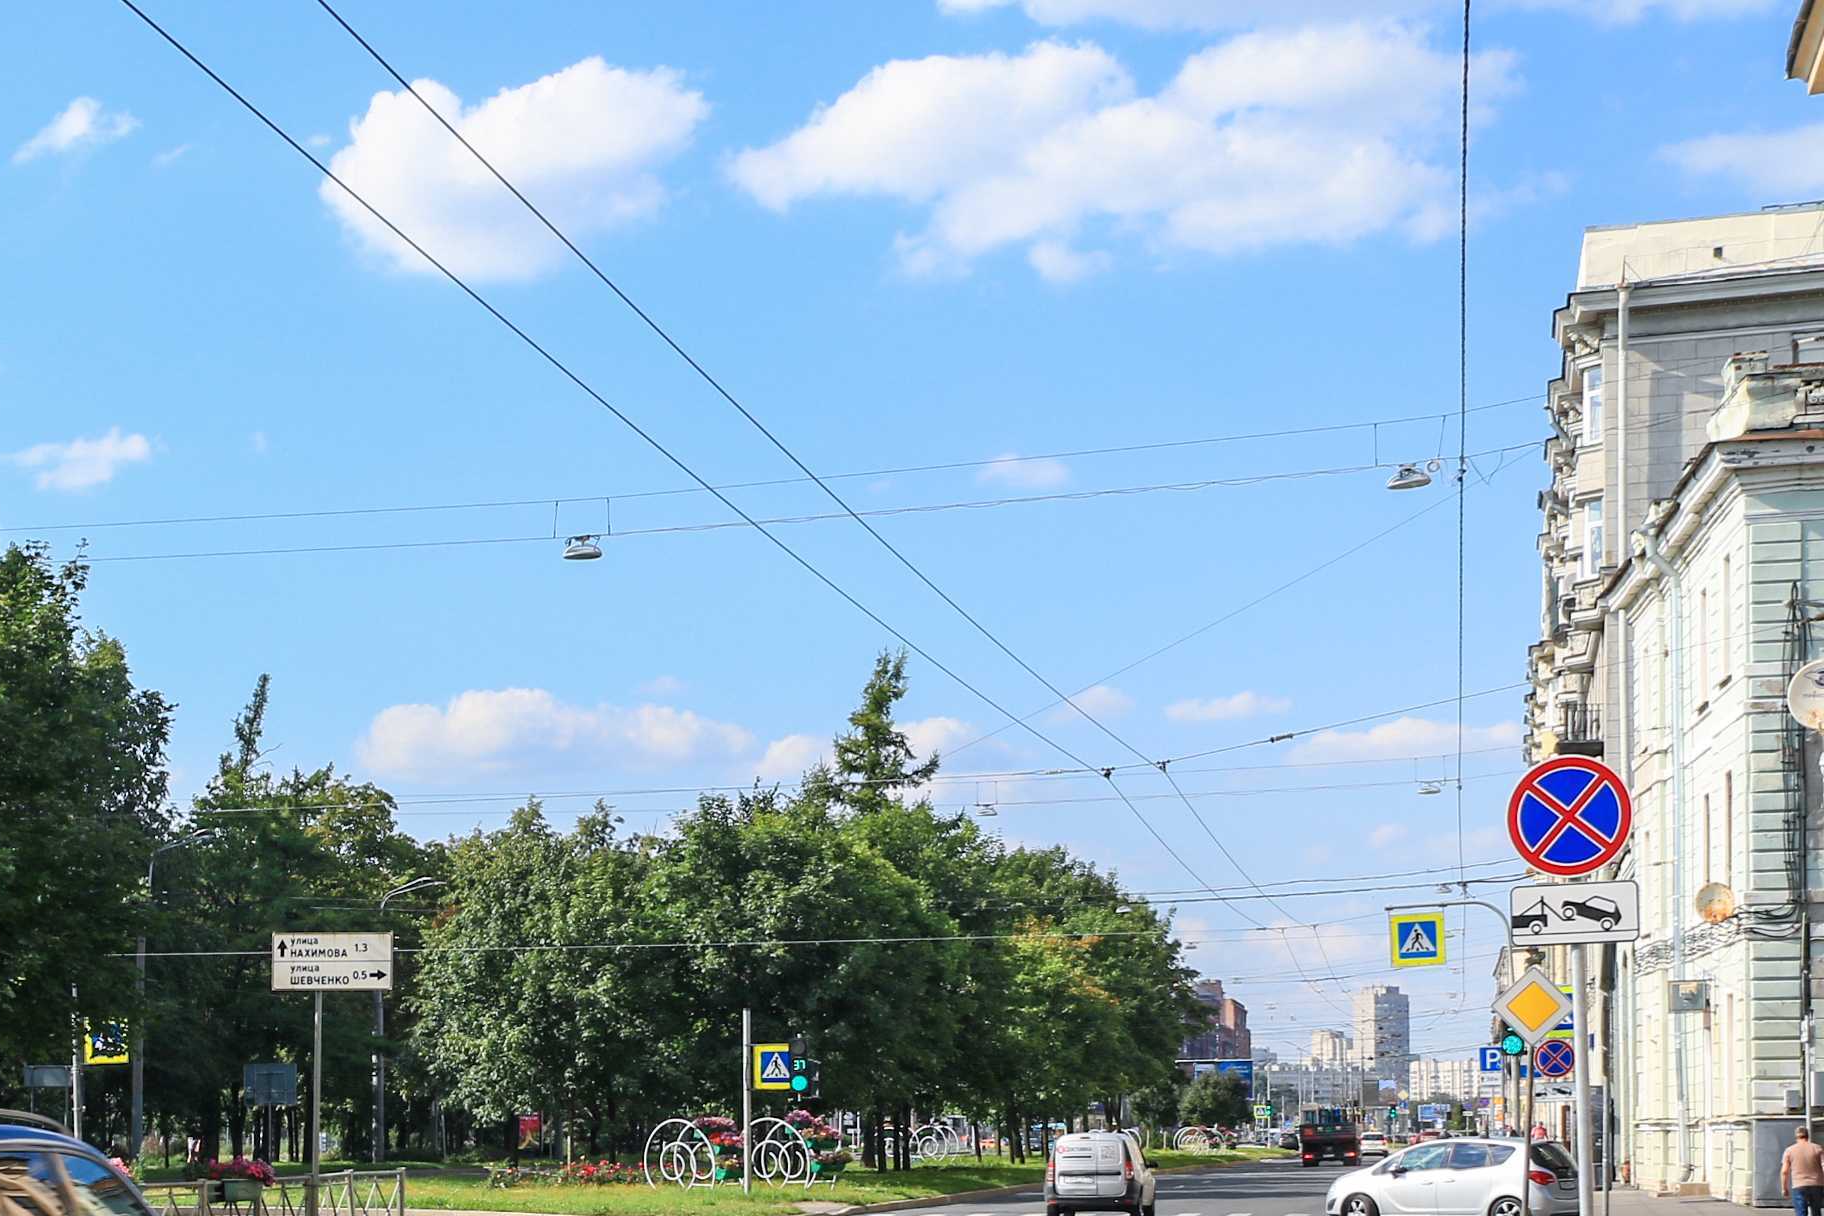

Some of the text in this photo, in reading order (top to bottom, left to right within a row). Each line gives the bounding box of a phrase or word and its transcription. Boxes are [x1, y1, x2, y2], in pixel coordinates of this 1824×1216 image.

[290, 937, 319, 946] улица
[290, 948, 348, 958] НАХИМОВА
[290, 965, 320, 973] улица
[290, 975, 350, 985] ШЕВЧЕНКО
[793, 1059, 806, 1071] 37
